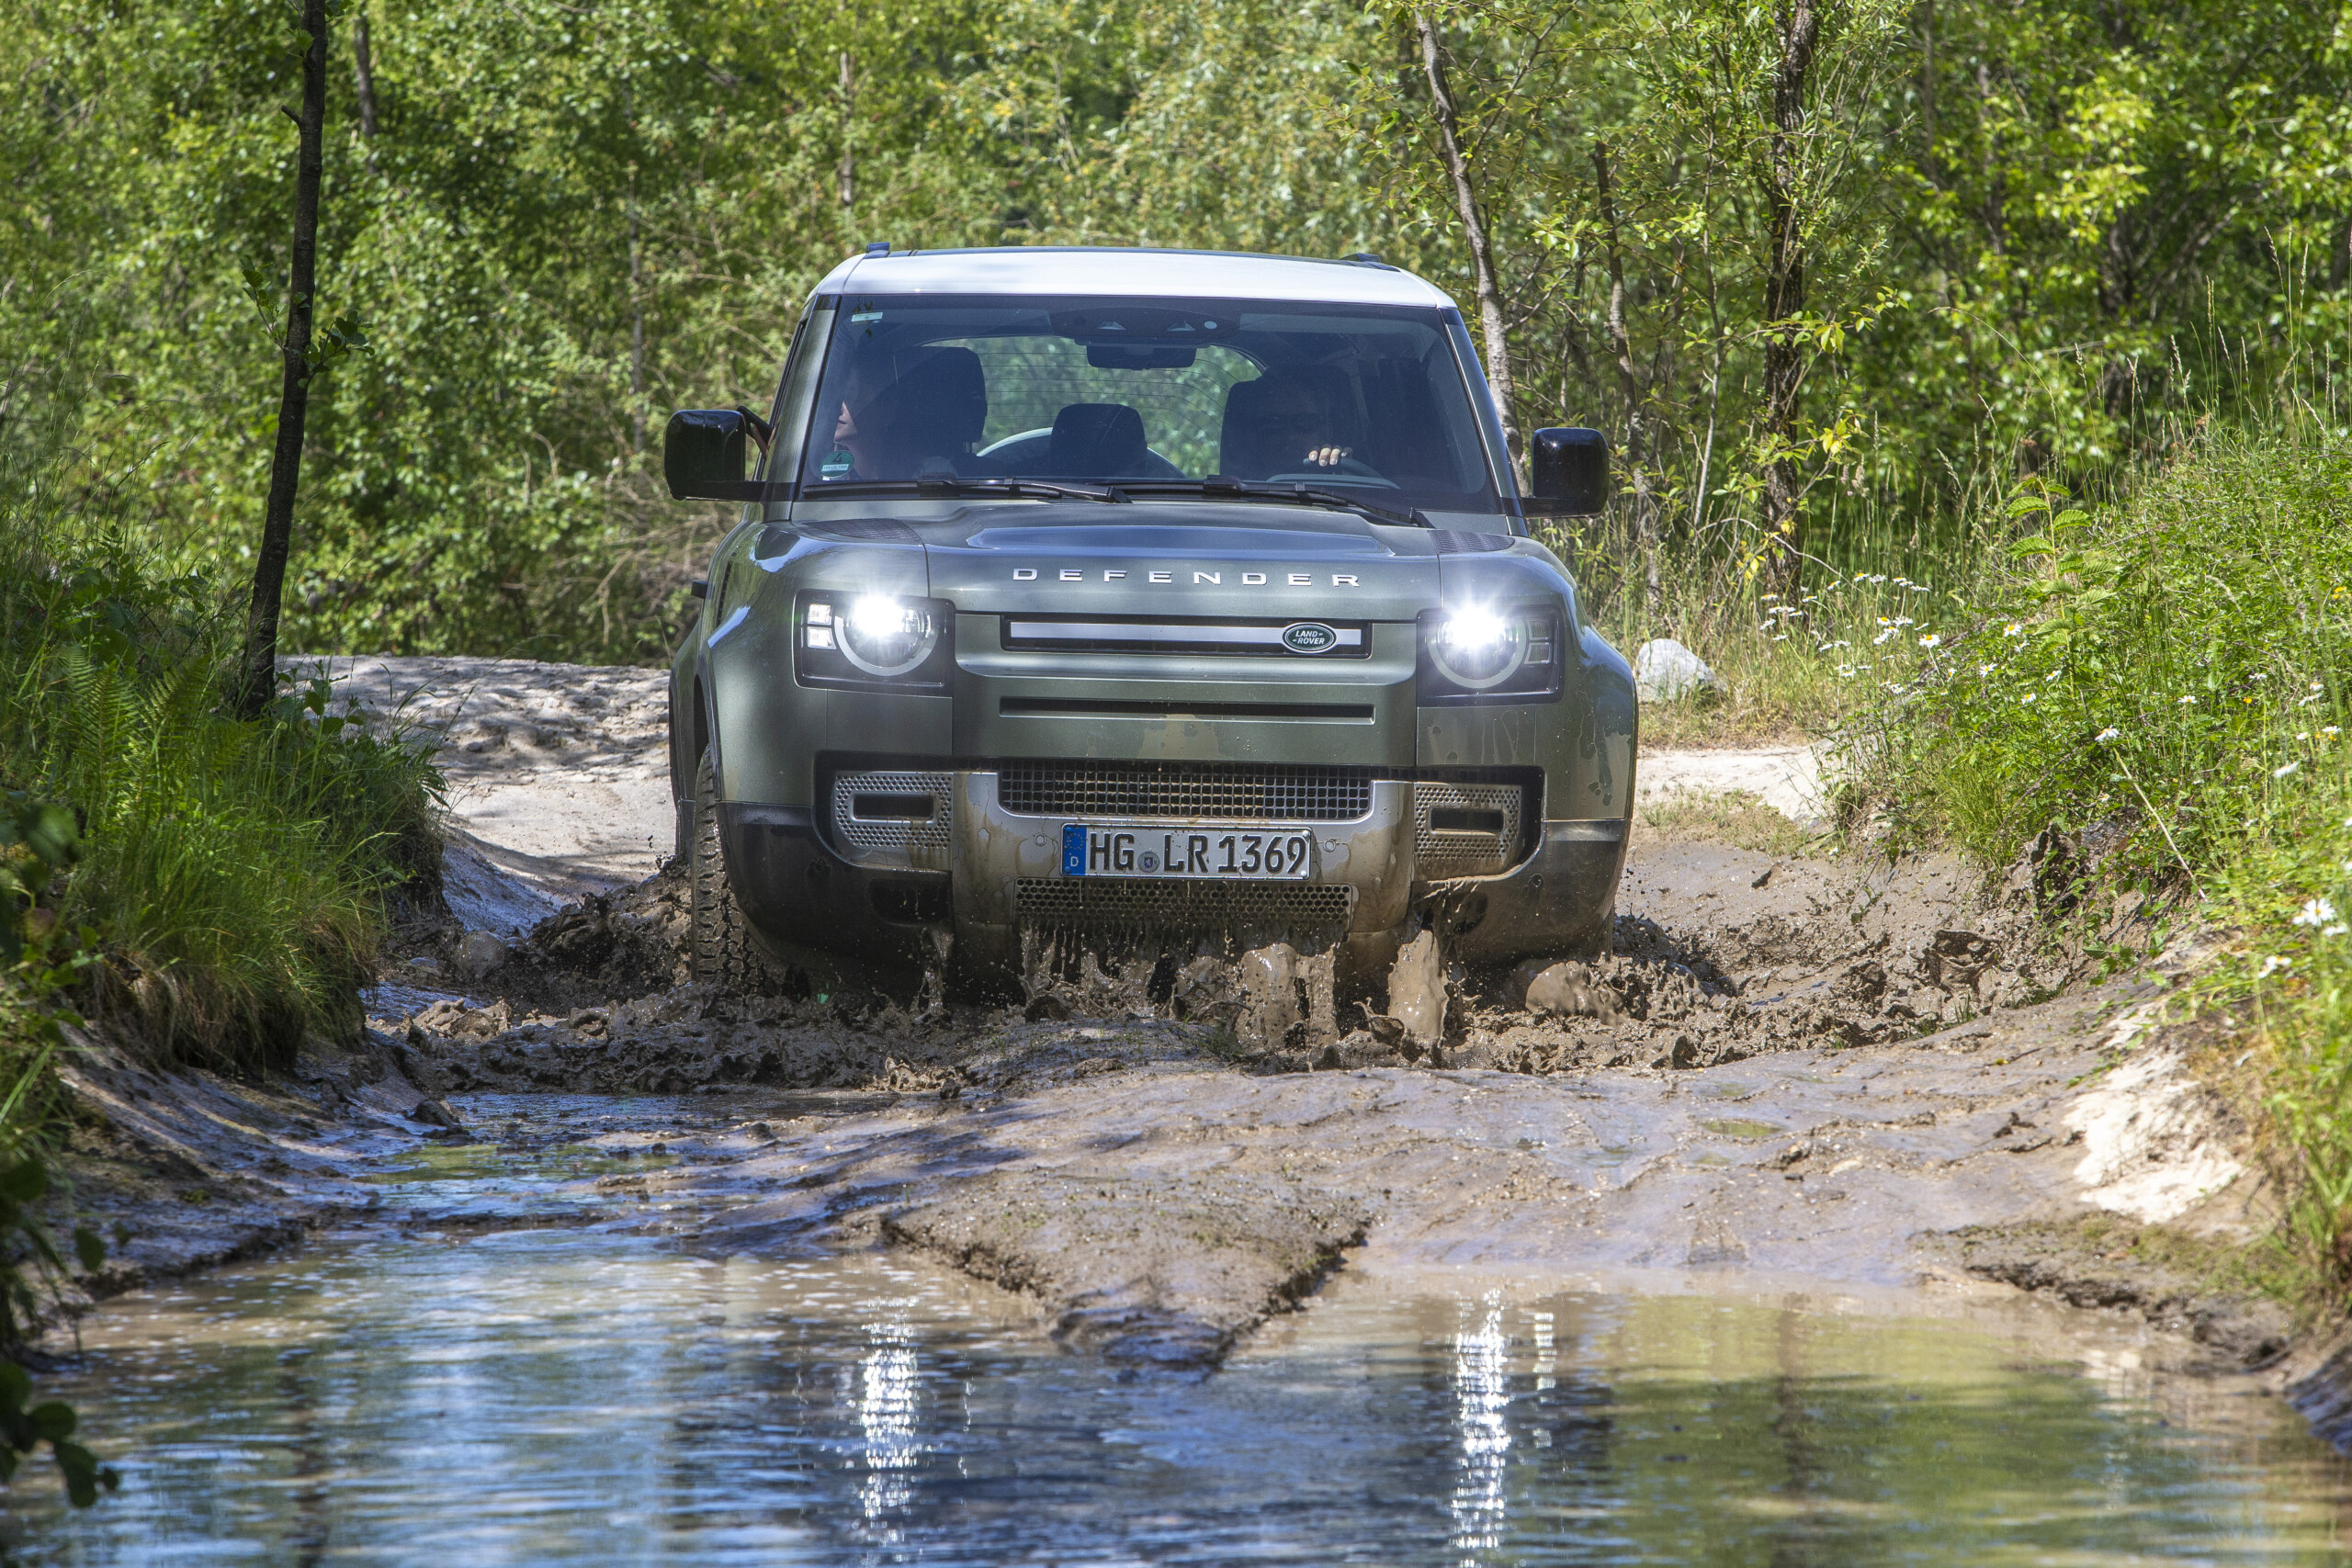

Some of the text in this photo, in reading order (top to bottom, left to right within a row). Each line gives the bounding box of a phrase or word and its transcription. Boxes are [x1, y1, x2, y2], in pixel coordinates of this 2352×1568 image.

[831, 452, 842, 463] 4
[1012, 568, 1361, 588] DEFENDER
[1090, 832, 1307, 874] HG LR 1369
[1069, 856, 1080, 867] D
